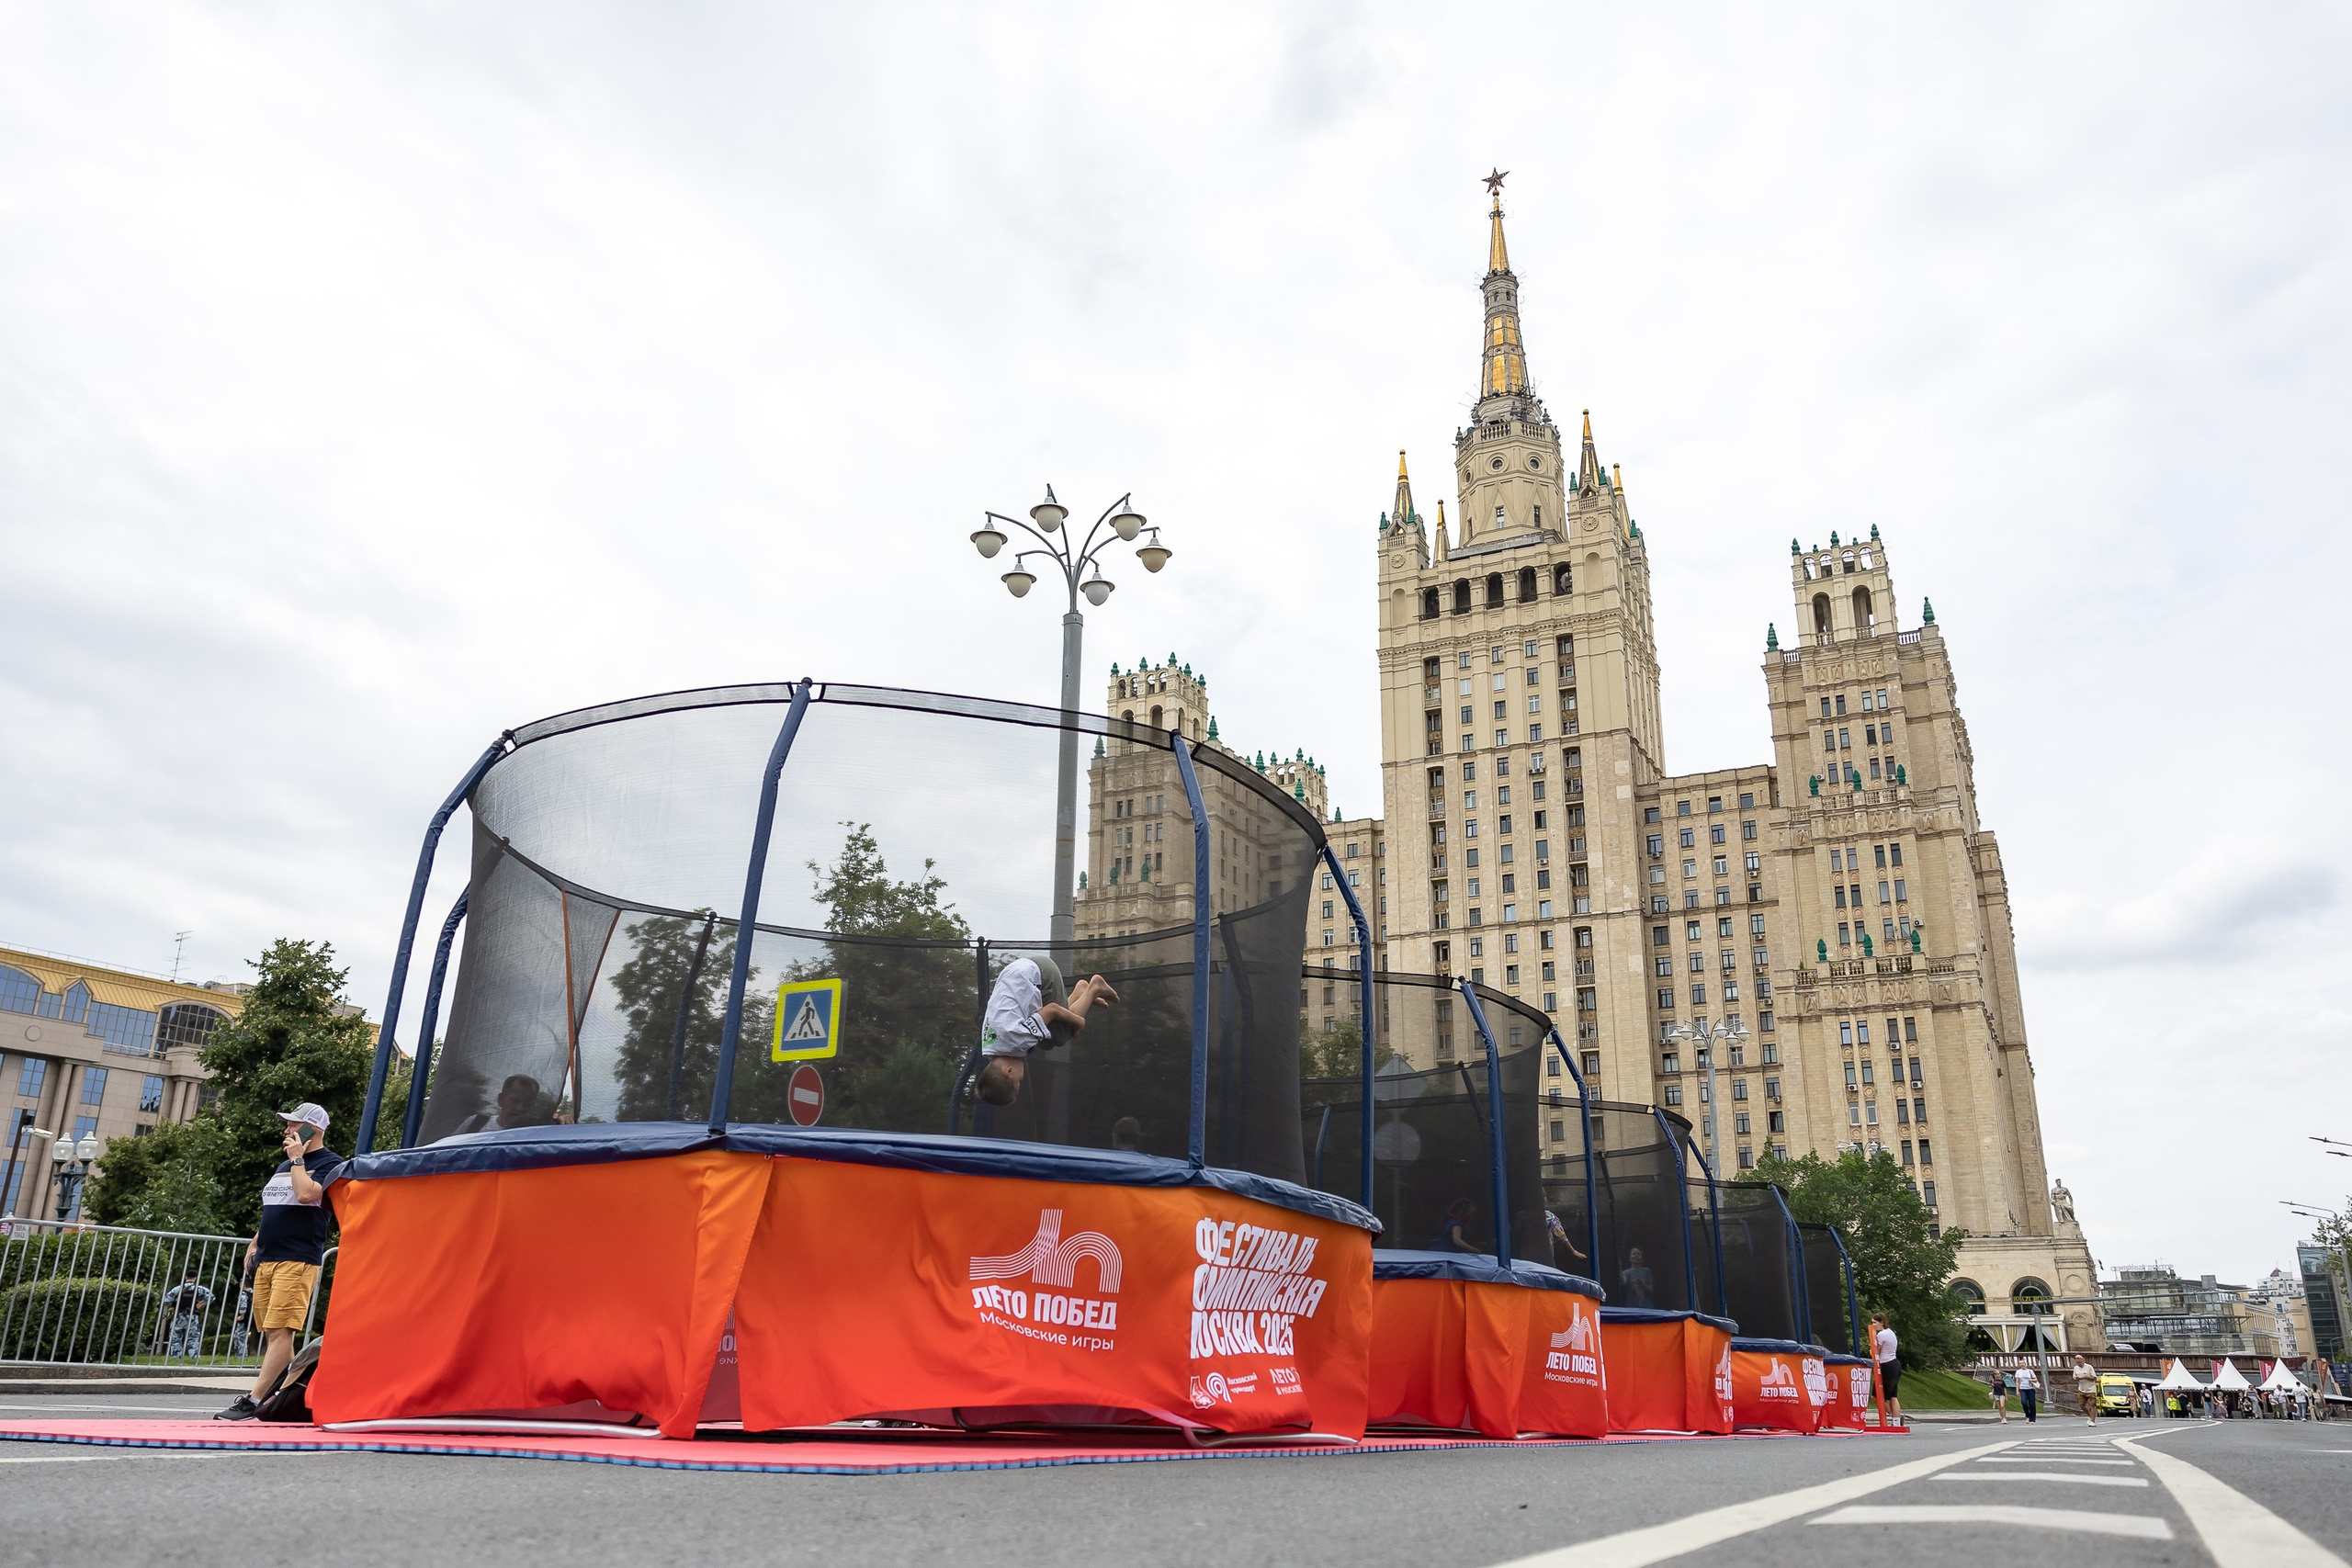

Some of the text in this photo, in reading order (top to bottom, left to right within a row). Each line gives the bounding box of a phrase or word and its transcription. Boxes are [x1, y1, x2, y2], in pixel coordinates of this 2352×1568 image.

[1195, 1217, 1319, 1275] ФЕСТИВАЛЬ
[971, 1285, 1117, 1330] ЛЕТО ПОБЕД
[979, 1311, 1114, 1352] Московские игры
[1546, 1351, 1569, 1371] ЛЕТО
[1269, 1368, 1296, 1384] ЛЕТО
[1544, 1371, 1585, 1384] Московские
[1760, 1387, 1779, 1397] ЛЕТО
